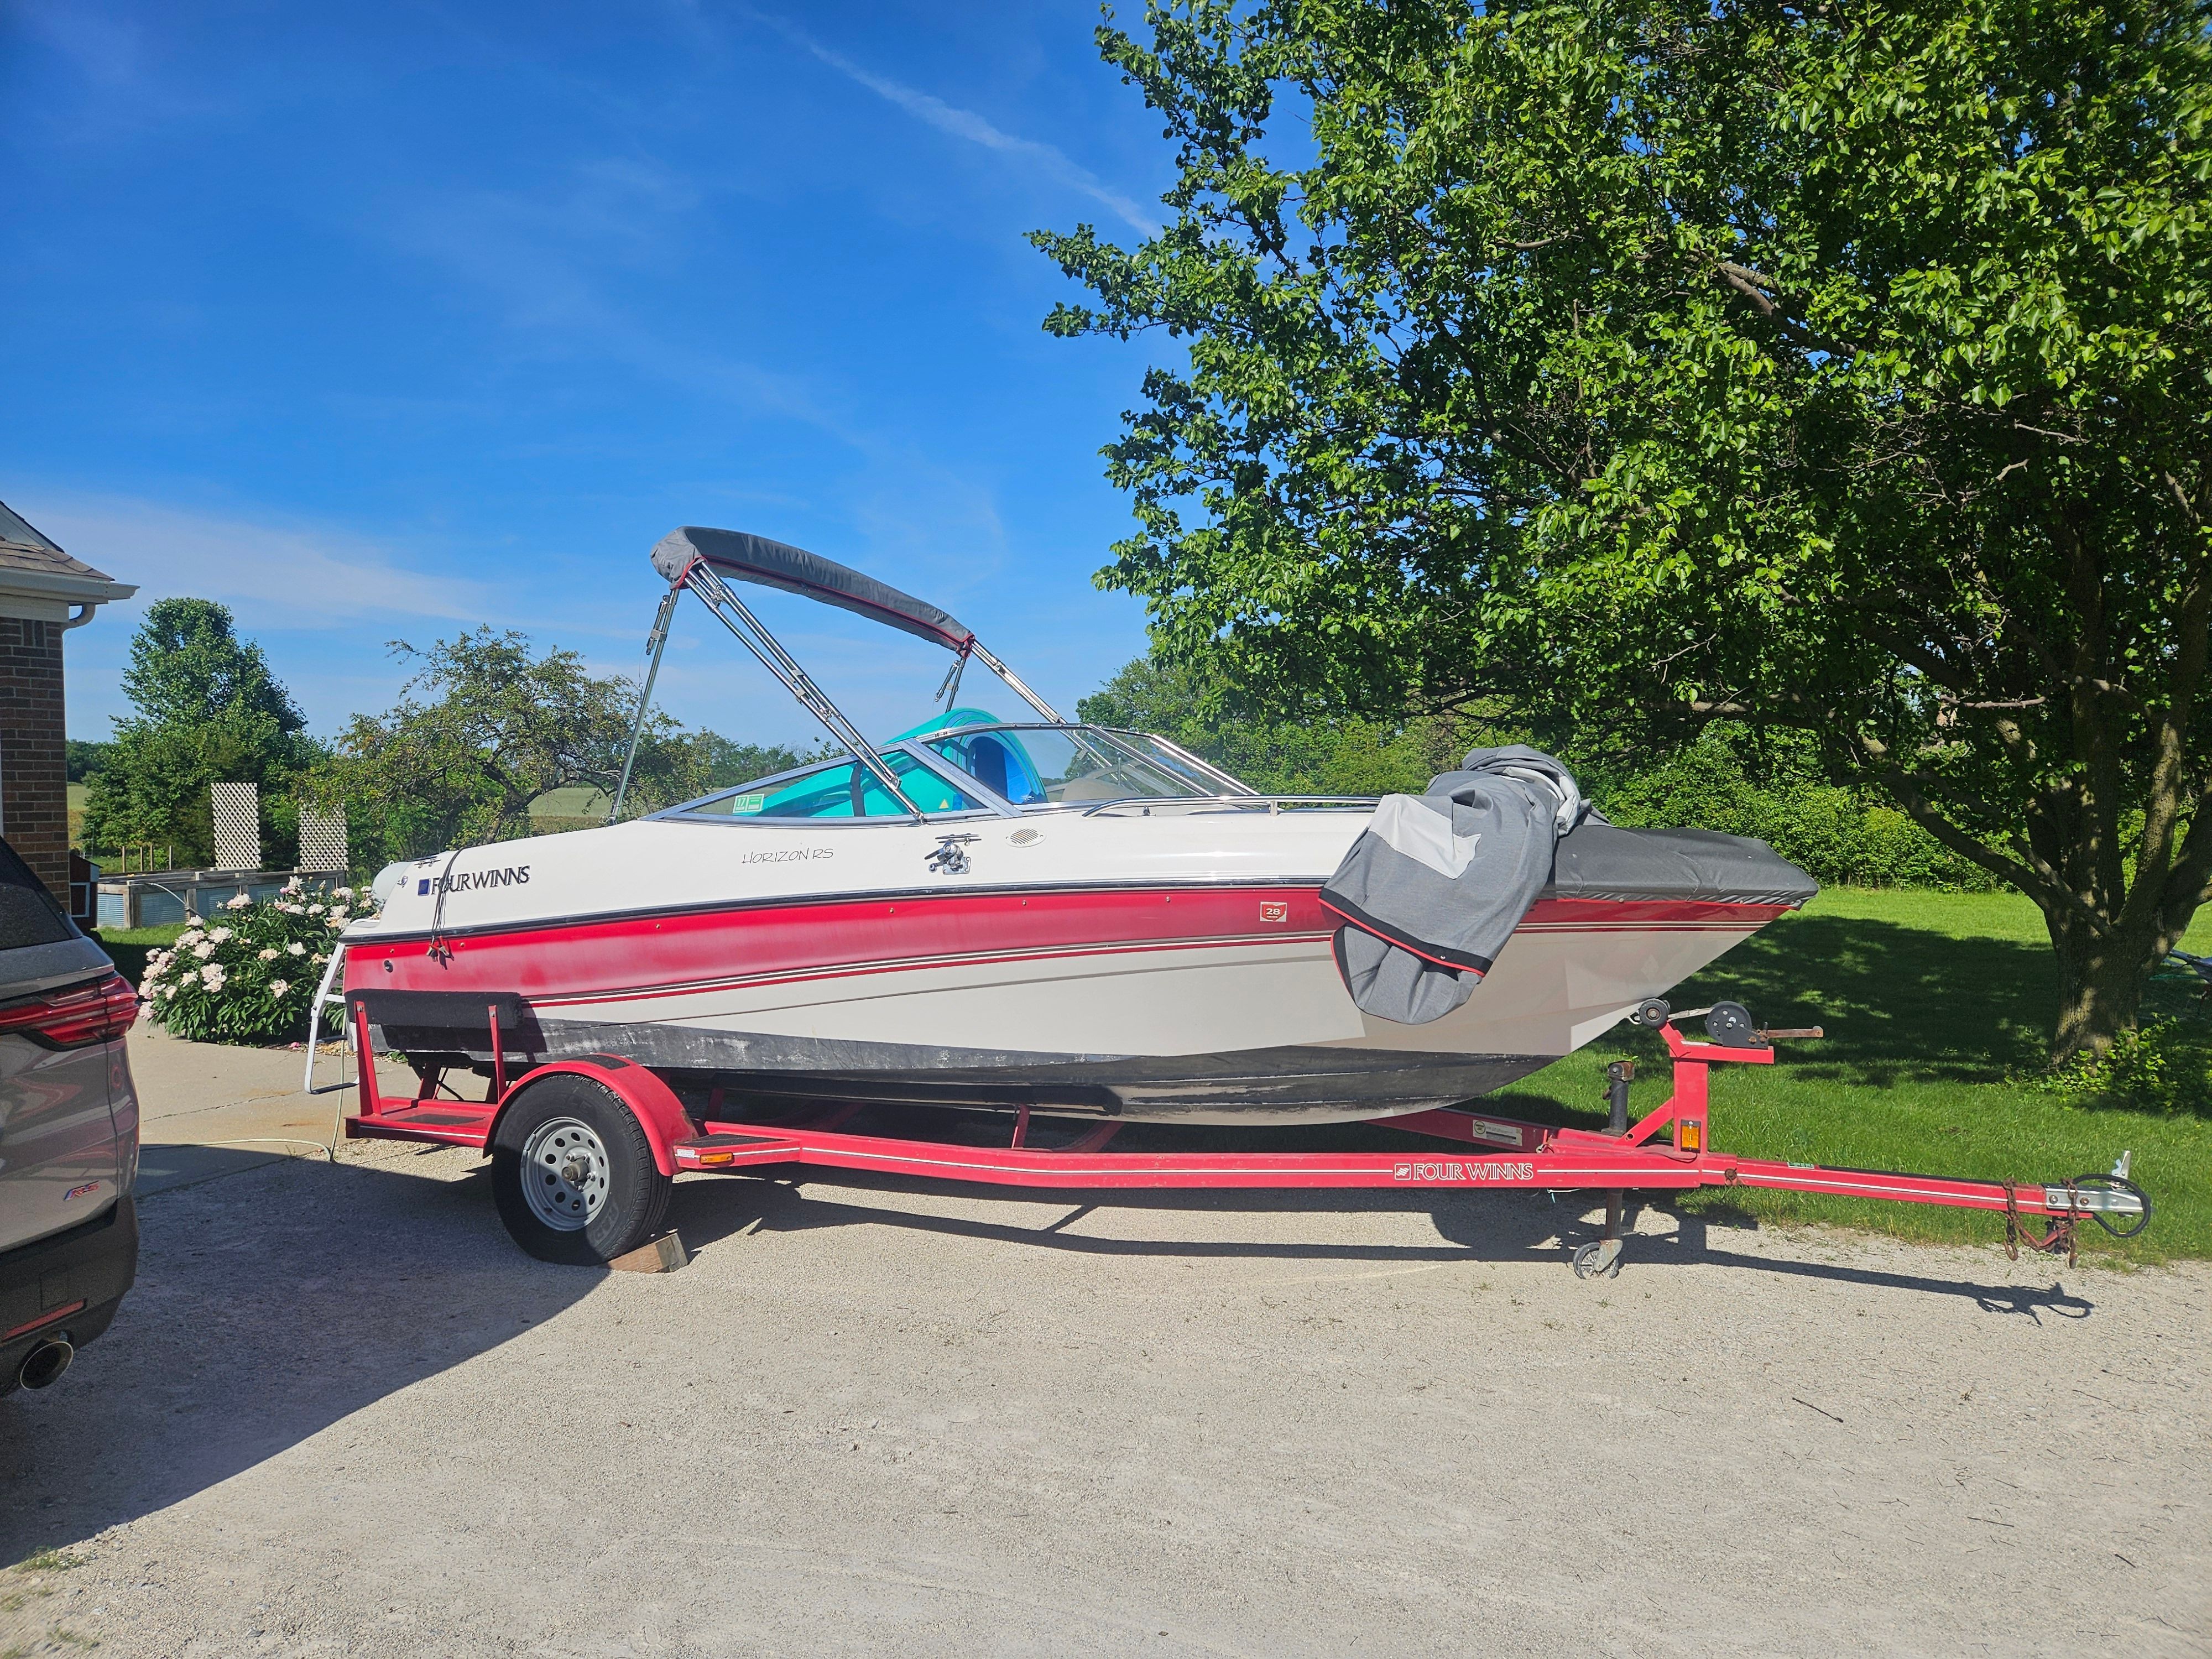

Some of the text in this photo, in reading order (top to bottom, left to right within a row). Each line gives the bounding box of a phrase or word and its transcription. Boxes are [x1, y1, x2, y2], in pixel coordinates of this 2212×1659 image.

[742, 848, 833, 864] HORIZON RS
[472, 865, 531, 889] WINNS
[1413, 1163, 1534, 1181] FOUR WINNS
